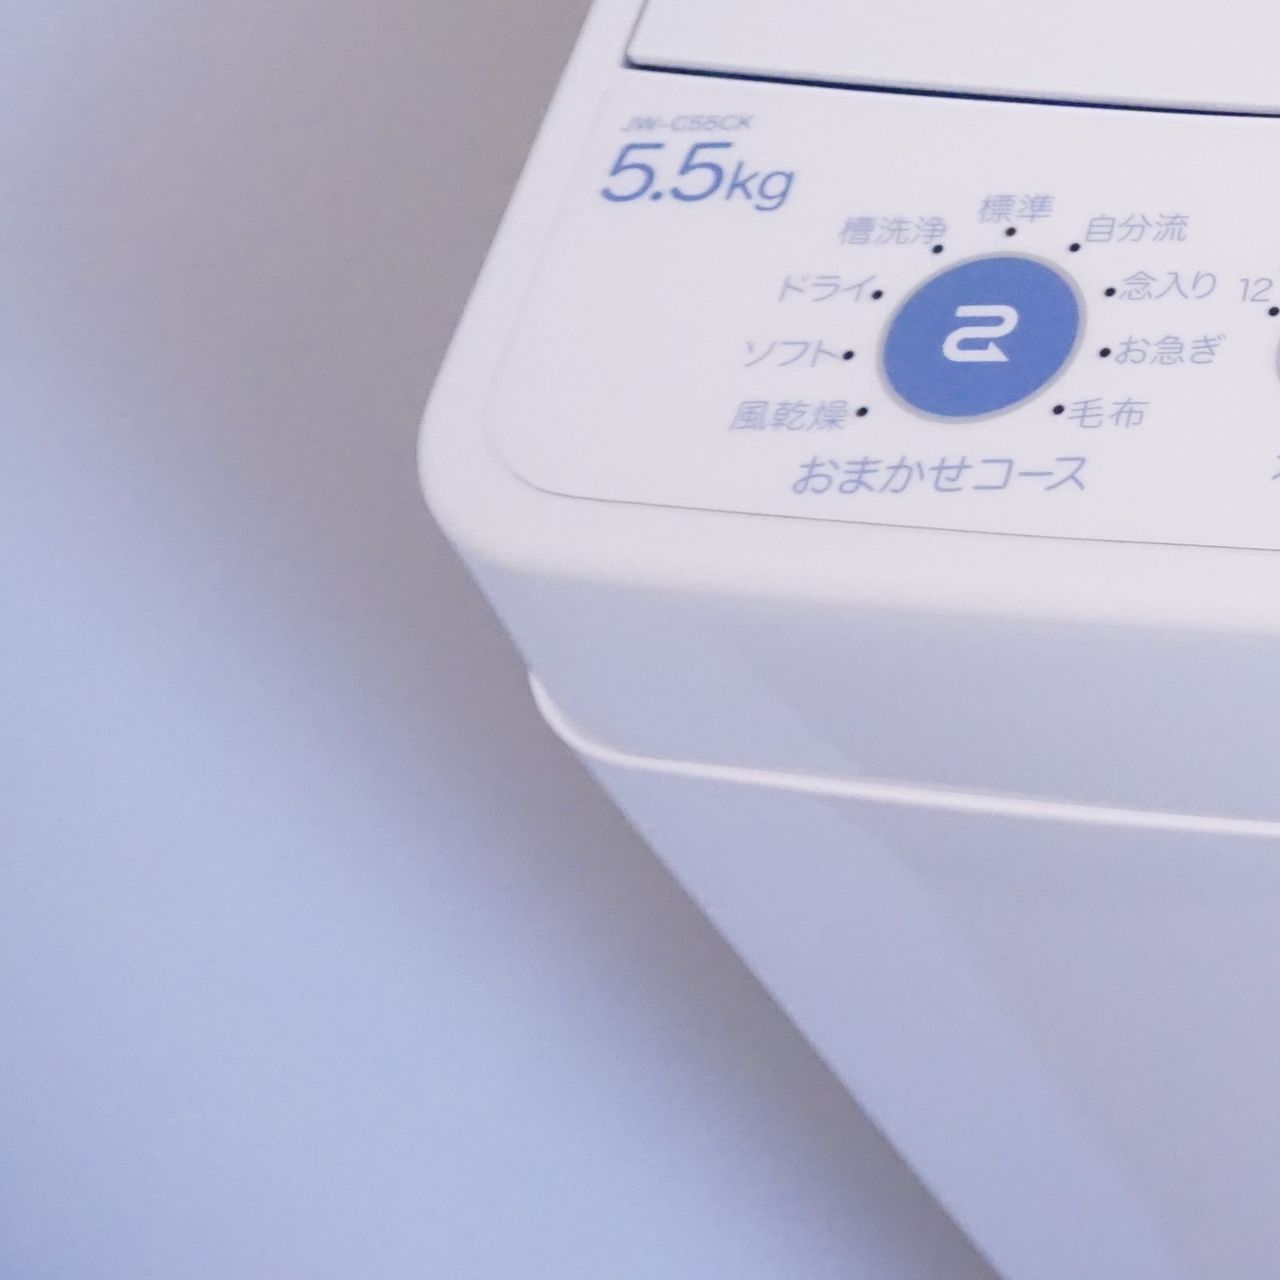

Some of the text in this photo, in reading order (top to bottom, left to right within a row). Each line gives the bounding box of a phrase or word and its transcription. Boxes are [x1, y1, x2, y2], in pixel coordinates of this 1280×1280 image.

[600, 141, 794, 211] 5.5kg
[978, 194, 1054, 223] 標準
[838, 216, 947, 244] 槽洗浄
[1085, 213, 1189, 243] 自分流
[778, 274, 872, 302] ドライ
[1121, 270, 1216, 300] 念入り
[1241, 278, 1273, 302] 12
[744, 340, 842, 367] ソフト
[1115, 334, 1226, 365] お急ぎ
[728, 400, 849, 431] 風乾燥
[1068, 397, 1149, 428] 毛布
[791, 456, 1086, 495] おまかせコース
